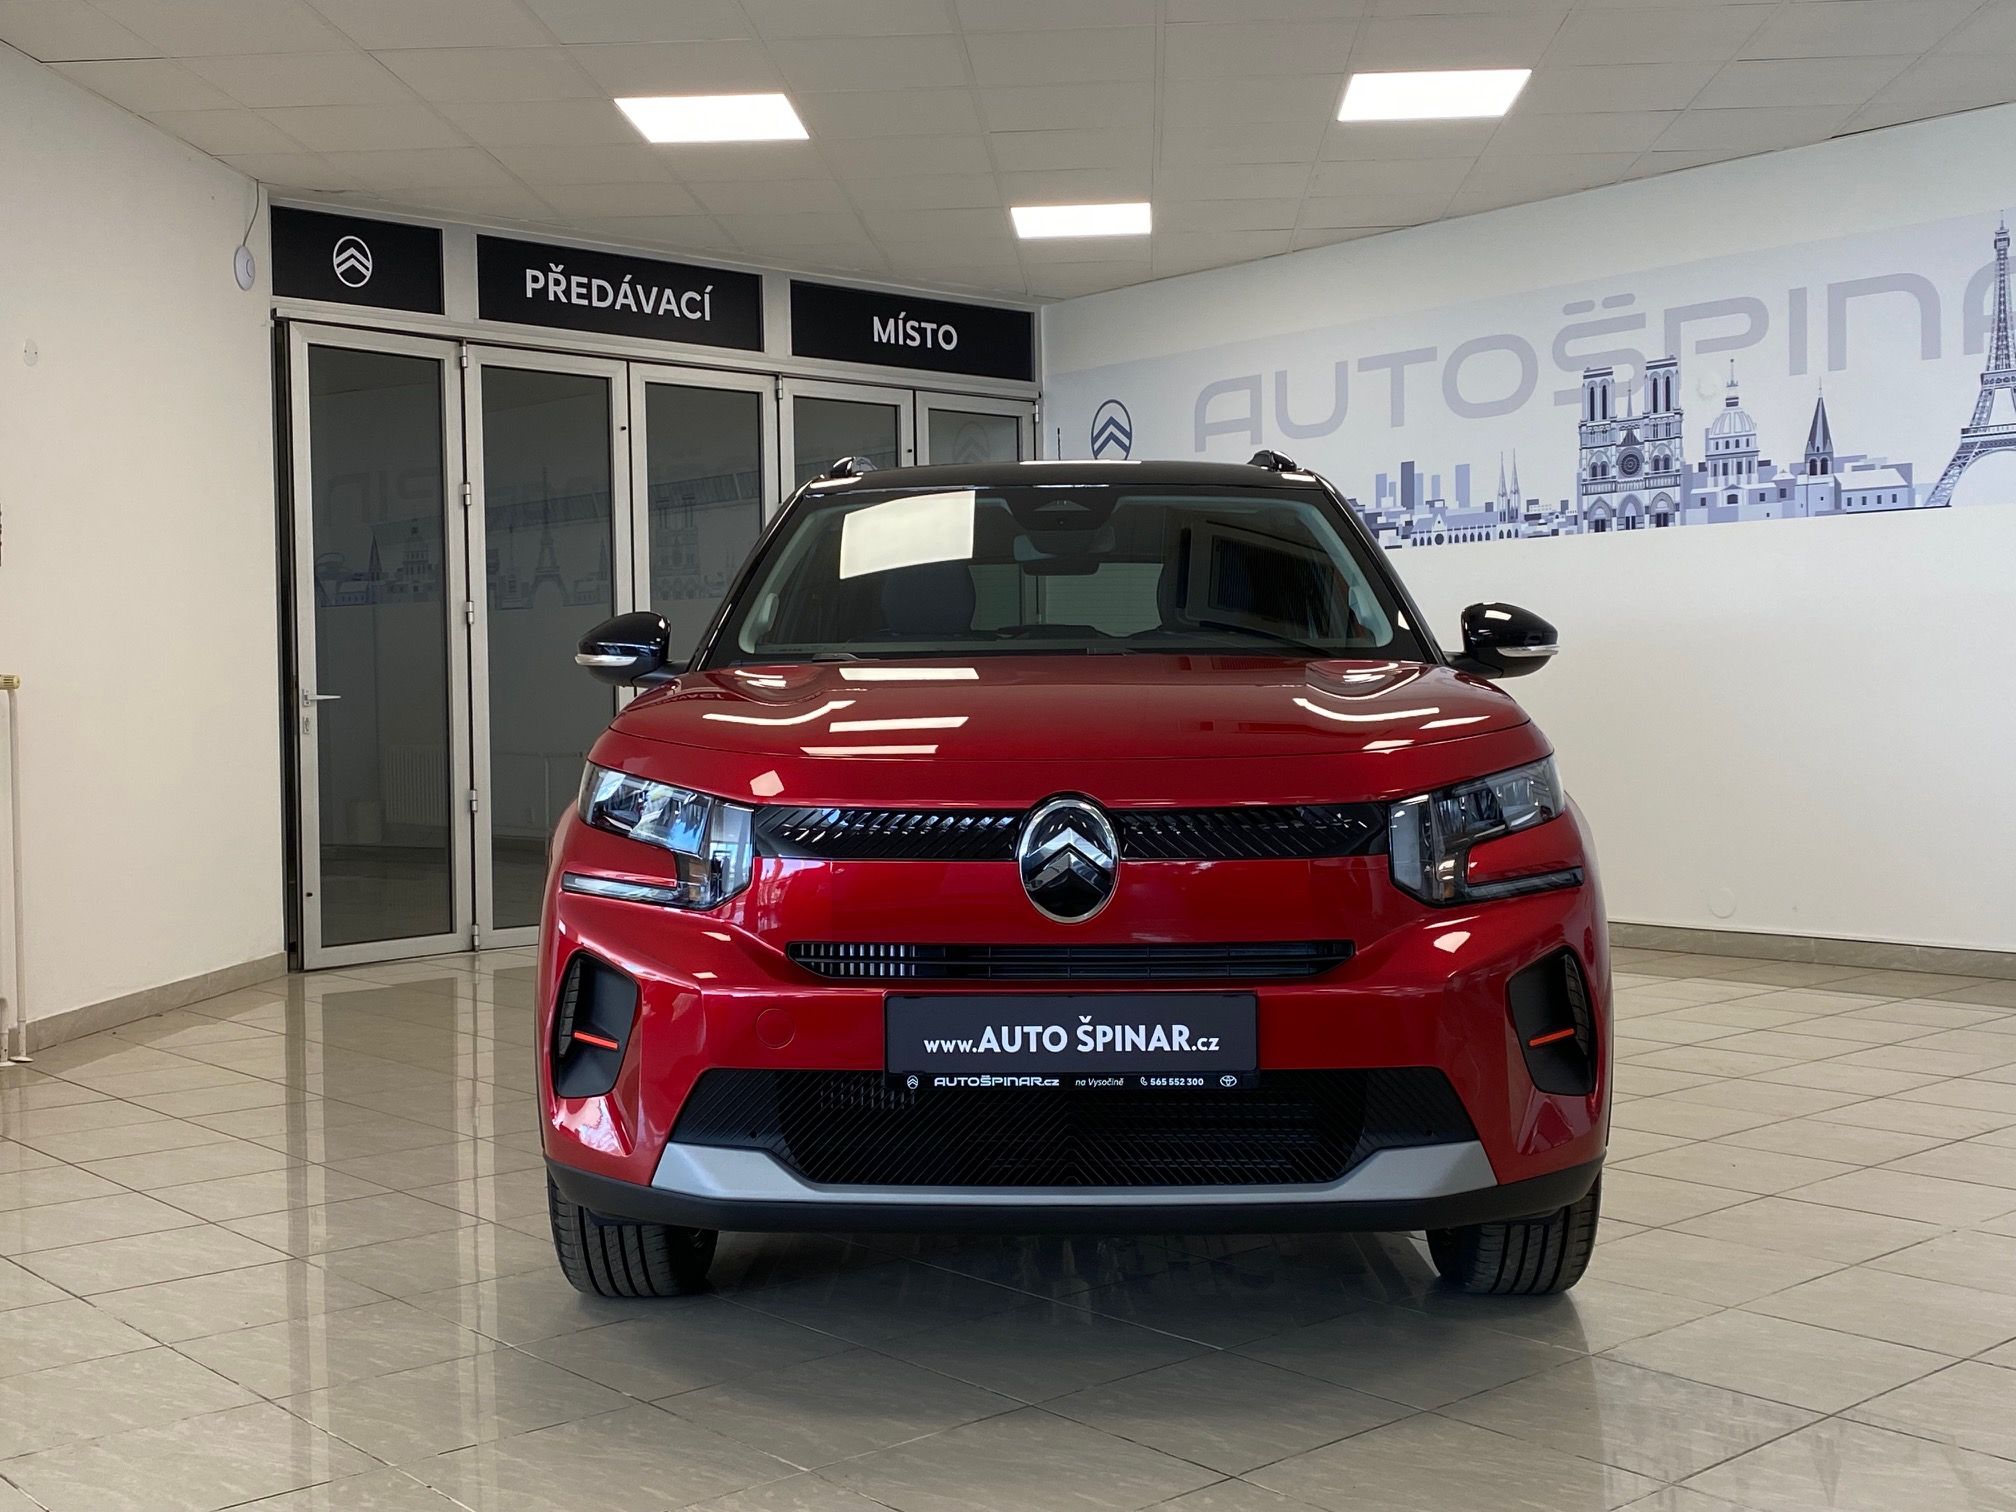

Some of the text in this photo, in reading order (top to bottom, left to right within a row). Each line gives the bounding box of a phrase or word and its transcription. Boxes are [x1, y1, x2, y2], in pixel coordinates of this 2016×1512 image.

[524, 263, 958, 351] PŘEDÁVACÍ MÍSTO
[923, 1015, 1220, 1054] www.AUTO ŠPINAR.cz
[1075, 1078, 1087, 1087] na
[1088, 1077, 1124, 1088] Vysočině
[1150, 1077, 1167, 1086] 565
[1168, 1077, 1185, 1086] 552
[1186, 1077, 1204, 1086] 300
